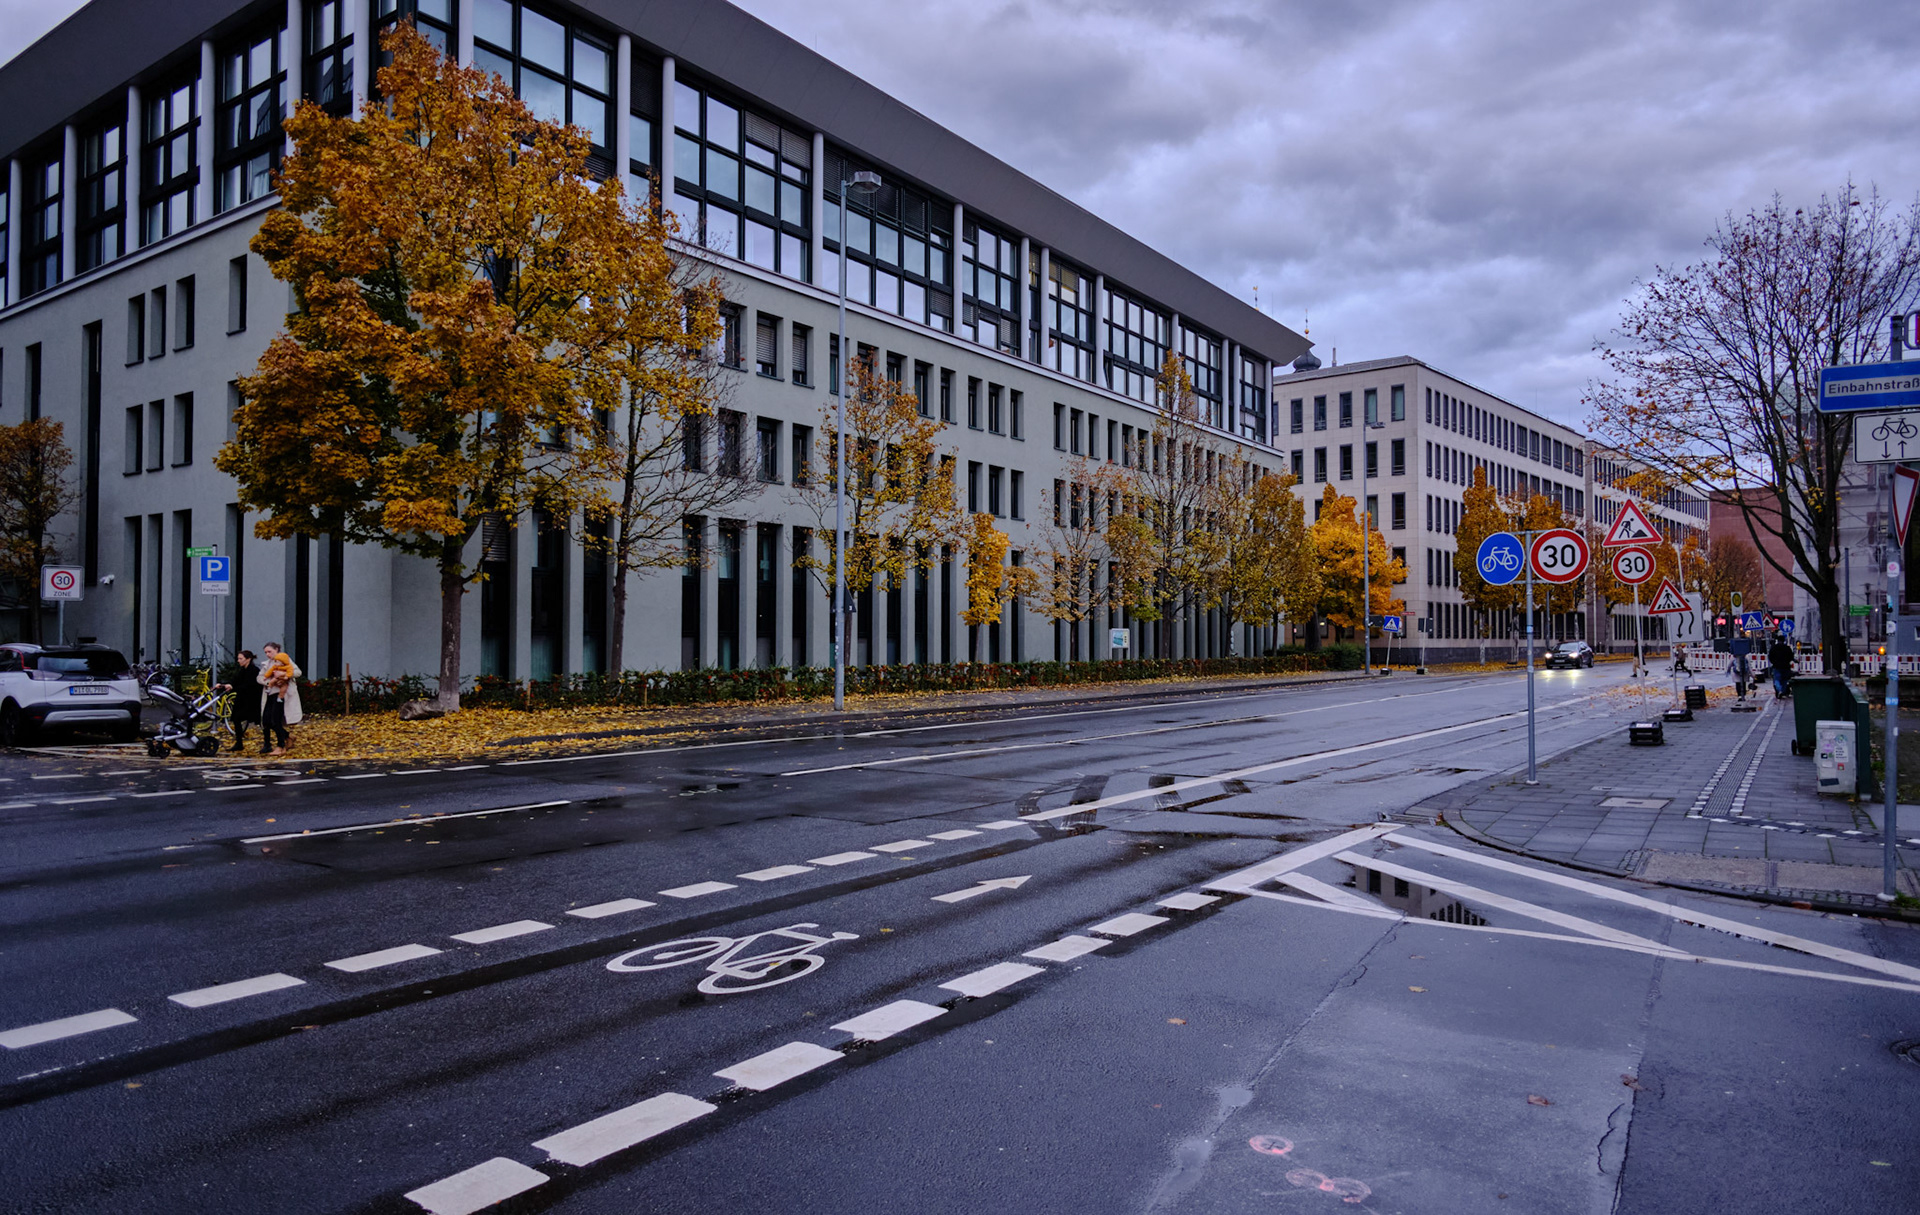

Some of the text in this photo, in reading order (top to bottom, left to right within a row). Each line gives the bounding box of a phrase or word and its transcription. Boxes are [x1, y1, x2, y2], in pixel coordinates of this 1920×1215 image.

[1828, 377, 1920, 394] Einbahnstraß
[1543, 544, 1575, 568] 30
[1621, 556, 1646, 574] 30
[207, 559, 223, 578] P
[56, 575, 71, 586] 30
